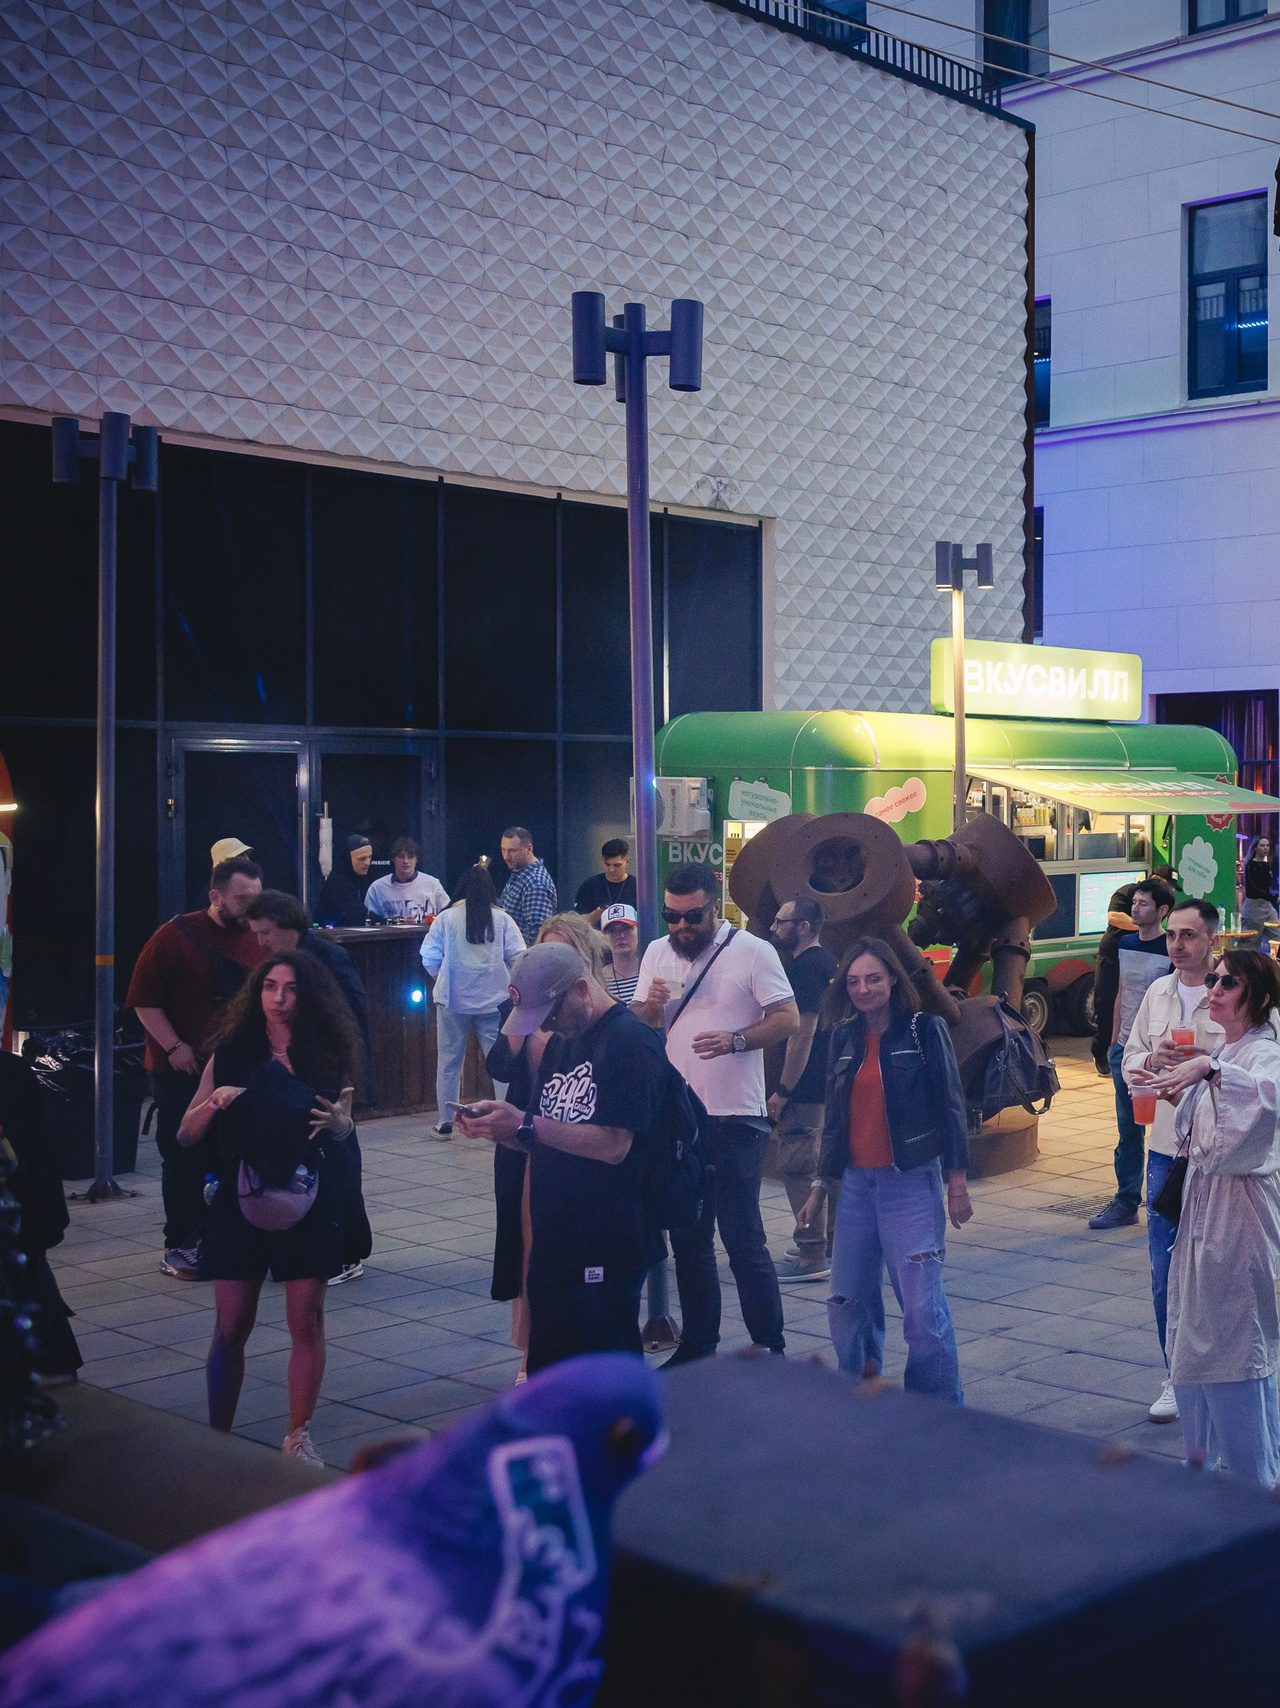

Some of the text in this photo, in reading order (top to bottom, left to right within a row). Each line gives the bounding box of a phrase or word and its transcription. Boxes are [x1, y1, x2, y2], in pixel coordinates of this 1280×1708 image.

[963, 659, 1129, 702] ВКУСВИЛЛ
[894, 791, 918, 808] свежее
[668, 842, 724, 866] ВКУС
